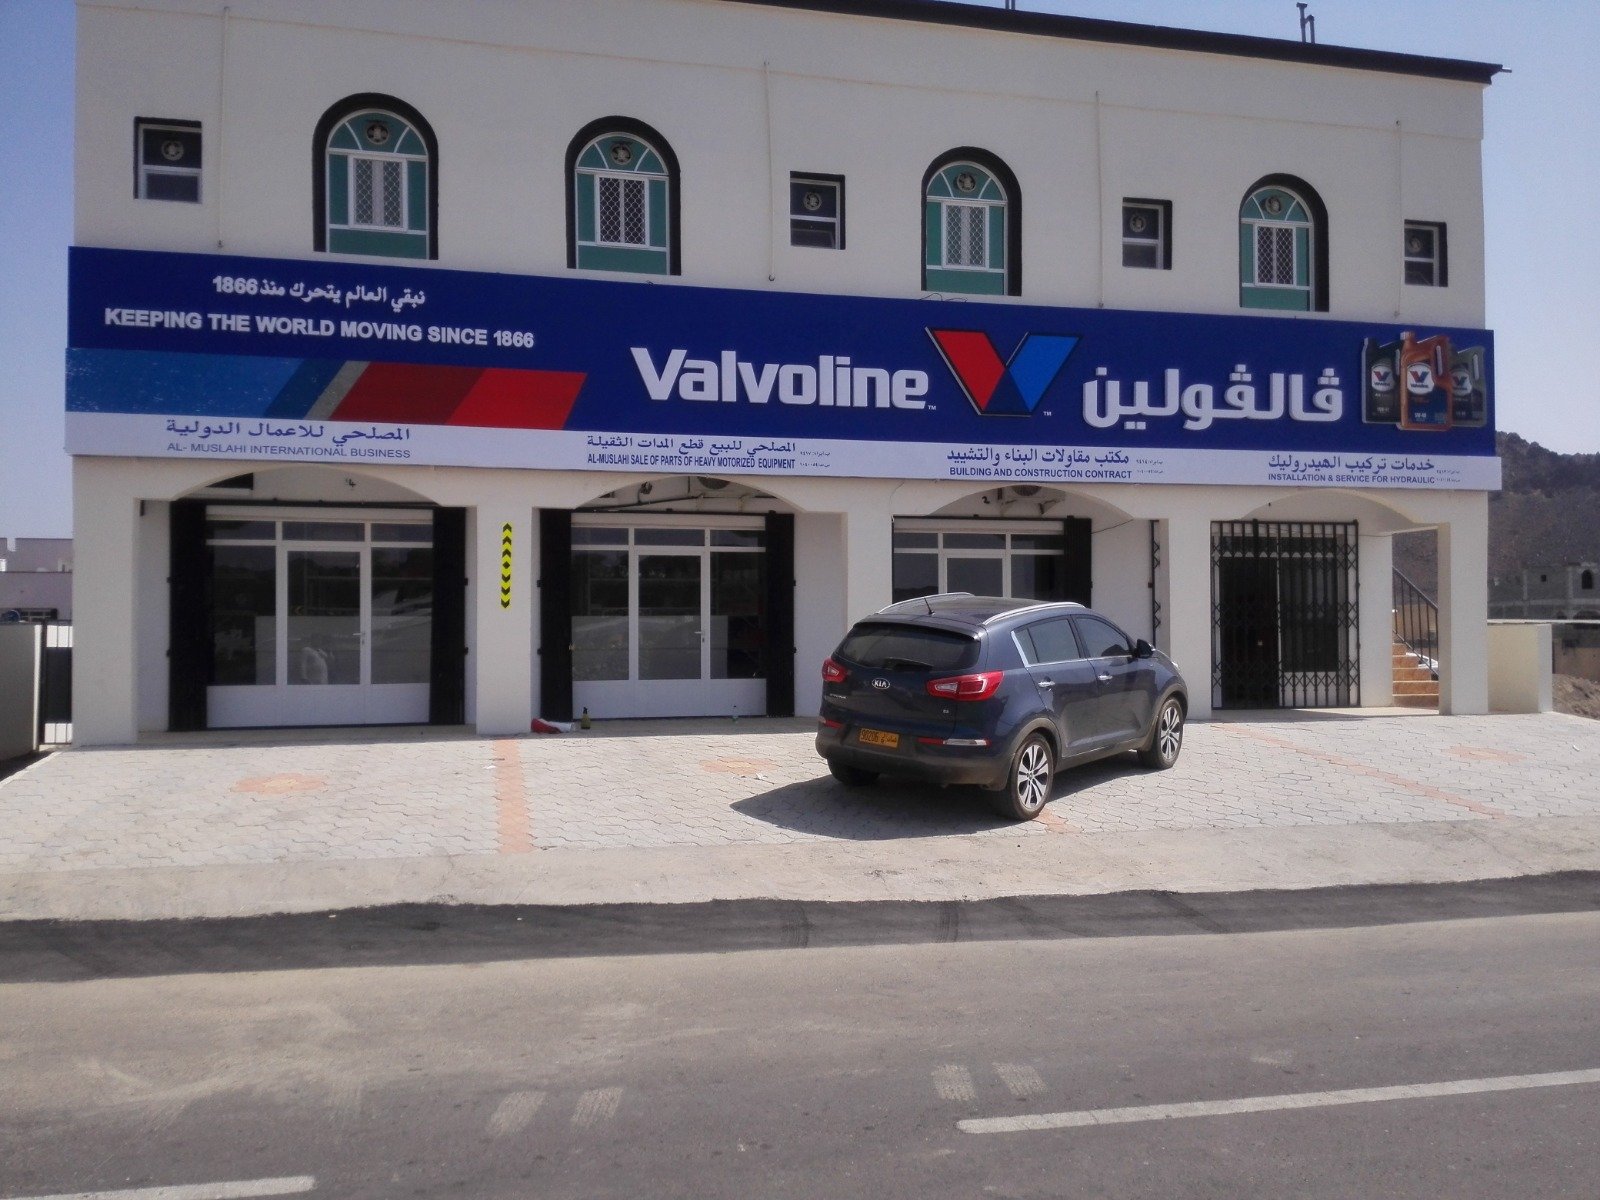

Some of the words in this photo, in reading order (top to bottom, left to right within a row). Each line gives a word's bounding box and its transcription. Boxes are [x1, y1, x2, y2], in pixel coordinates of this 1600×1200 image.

[213, 275, 258, 295] 1866
[260, 279, 286, 296] منذ
[289, 281, 341, 304] يتحرك
[345, 285, 387, 308] العالم
[104, 308, 201, 330] KEEPING
[207, 313, 251, 332] THE
[255, 315, 335, 337] WORLD
[340, 320, 423, 342] MOVING
[427, 326, 488, 346] SINCE
[493, 330, 535, 349] 1866
[629, 347, 929, 411] Valvoline
[166, 419, 240, 439] الدولية
[248, 422, 324, 438] للاعمال
[331, 427, 410, 448] المصلحي
[190, 443, 247, 453] MUSLAHI
[249, 445, 347, 457] INTERNATIONAL
[350, 448, 411, 459] BUSINESS
[587, 435, 633, 449] الثقيلة
[678, 438, 704, 455] قطع
[709, 440, 742, 455] للبيع
[746, 441, 796, 457] المصلحي
[587, 453, 630, 465] AL-MUSLAHI
[631, 454, 649, 465] SALE
[650, 455, 659, 465] OF
[660, 455, 682, 466] PARTS
[684, 456, 693, 466] OF
[694, 456, 717, 467] HEAVY
[717, 457, 756, 468] MOTORIZED
[758, 458, 796, 469] EQUIPMENT
[947, 447, 1001, 467] والتشييد
[1004, 447, 1038, 466] البناء
[1041, 448, 1091, 468] مقاولات
[1094, 449, 1130, 467] مكتب
[1268, 454, 1341, 473] الهيدروليك
[1345, 456, 1387, 475] تركيب
[1390, 457, 1435, 471] خدمات
[949, 466, 992, 476] BUILDING
[993, 468, 1013, 477] AND
[1014, 468, 1083, 478] CONSTRUCTION
[1084, 469, 1133, 479] CONTRACT
[1268, 473, 1326, 482] INSTALLATION
[1327, 474, 1334, 482] &
[1335, 474, 1370, 483] SERVICE
[1371, 475, 1388, 483] FOR
[1389, 476, 1435, 484] HYDRAULIC
[873, 680, 888, 688] KIA
